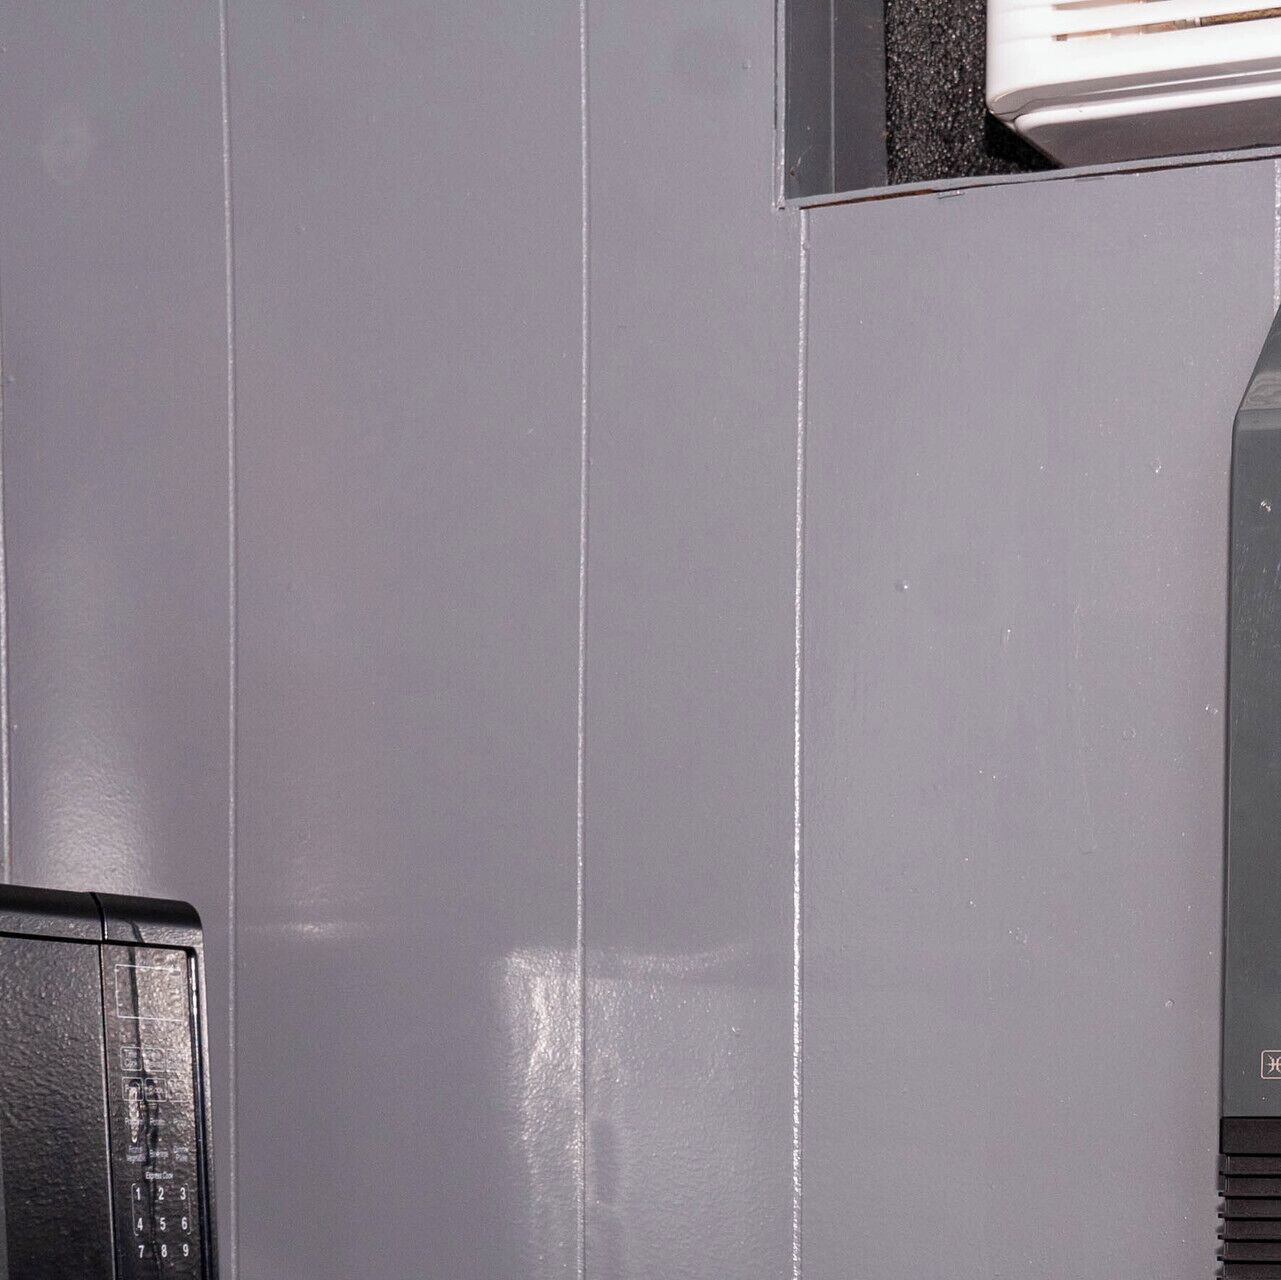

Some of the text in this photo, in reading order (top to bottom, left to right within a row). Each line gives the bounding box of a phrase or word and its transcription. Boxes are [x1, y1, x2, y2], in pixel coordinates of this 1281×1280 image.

[135, 1187, 141, 1200] 1
[158, 1187, 165, 1200] 2
[180, 1187, 187, 1200] 3
[137, 1217, 144, 1231] 4
[160, 1216, 167, 1231] 5
[181, 1216, 188, 1230] 6
[138, 1244, 145, 1258] 7
[161, 1244, 168, 1258] 8
[182, 1243, 189, 1257] 9
